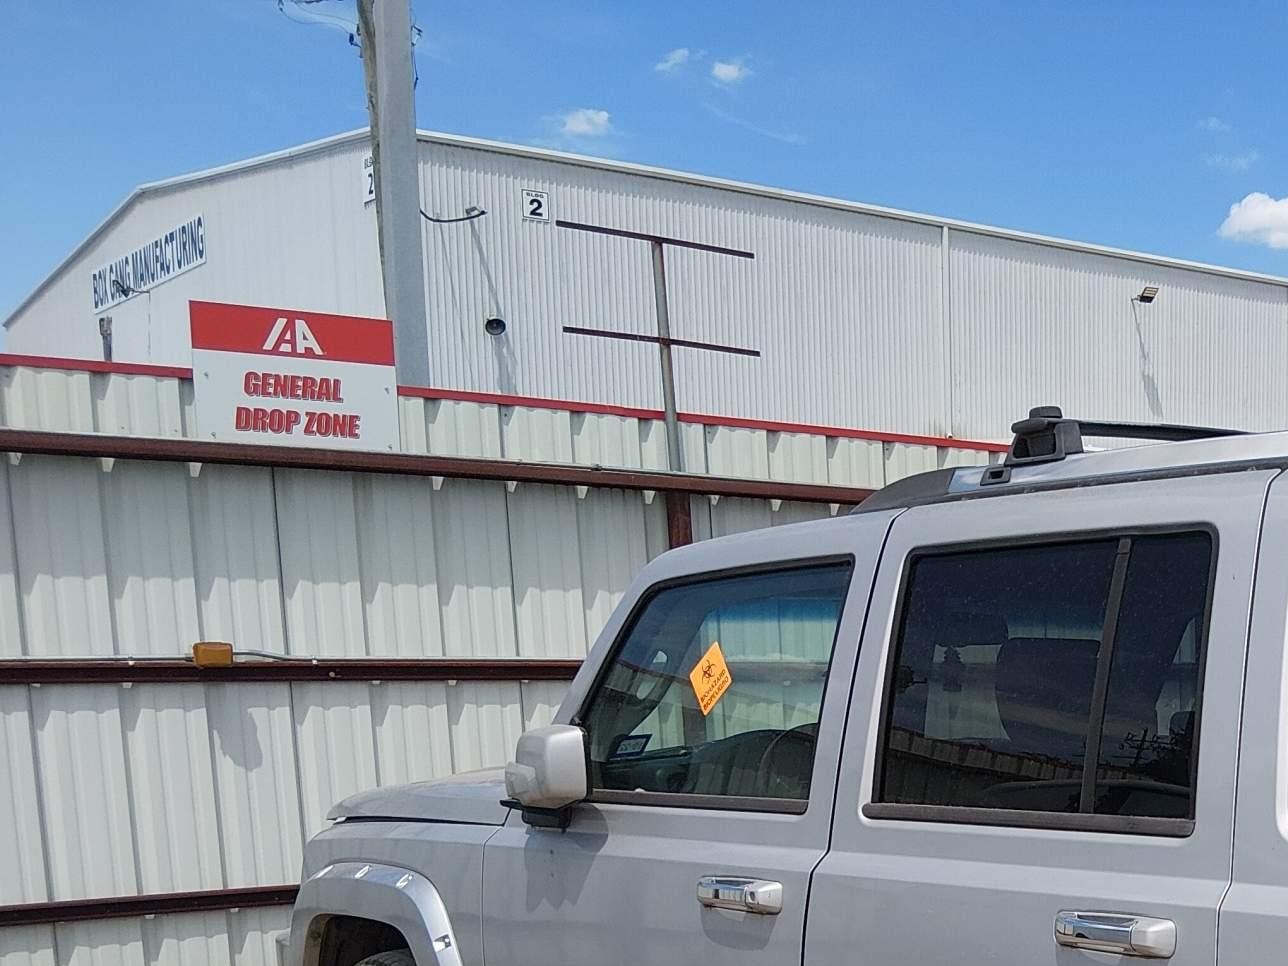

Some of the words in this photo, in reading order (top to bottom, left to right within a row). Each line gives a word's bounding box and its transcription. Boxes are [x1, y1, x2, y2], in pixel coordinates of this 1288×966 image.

[529, 198, 543, 217] 2
[93, 267, 109, 309] BOX
[131, 216, 204, 289] MANUFACTURING
[243, 371, 344, 403] GENERAL
[235, 406, 300, 434] DROP
[303, 411, 361, 439] ZONE
